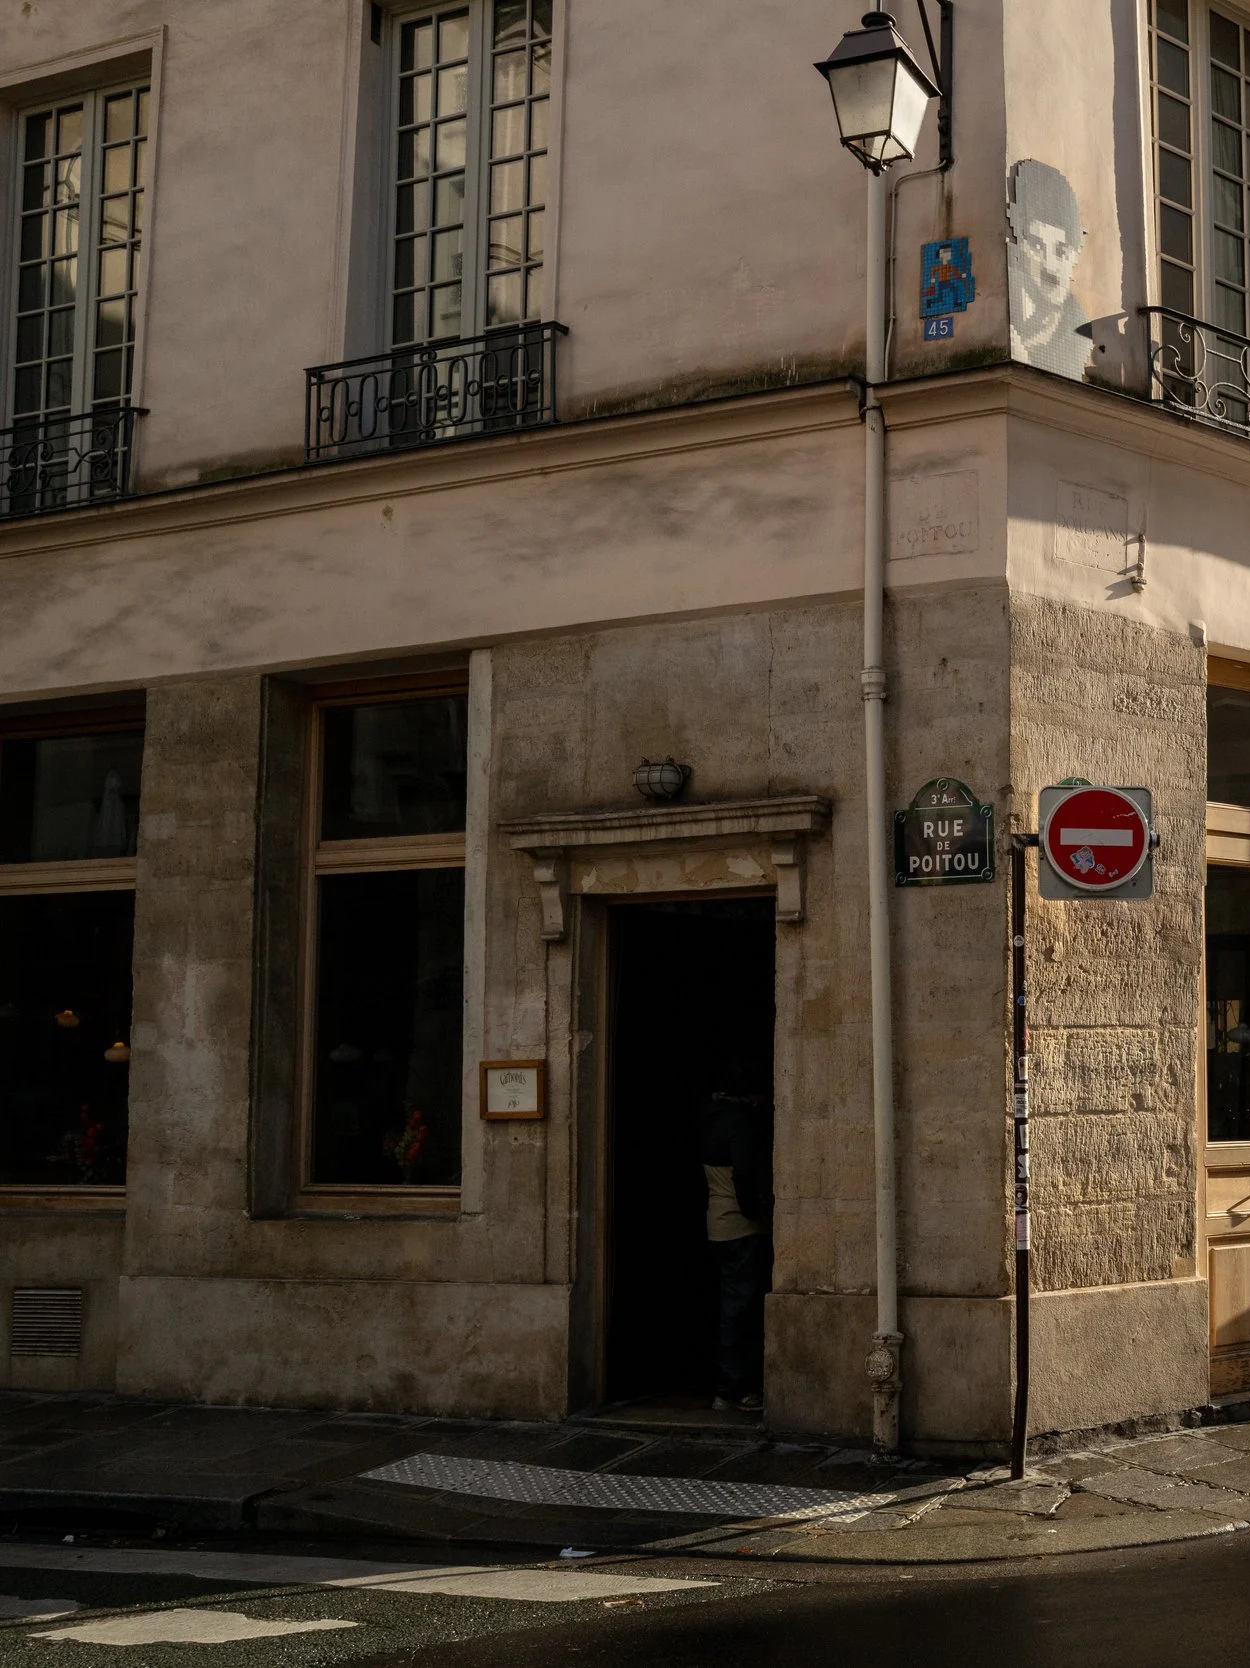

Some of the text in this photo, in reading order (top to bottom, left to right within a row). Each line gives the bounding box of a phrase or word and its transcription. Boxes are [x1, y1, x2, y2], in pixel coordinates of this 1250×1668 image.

[928, 320, 948, 336] 45
[923, 819, 964, 838] RUE
[936, 841, 950, 850] DE
[909, 853, 979, 872] POITOU
